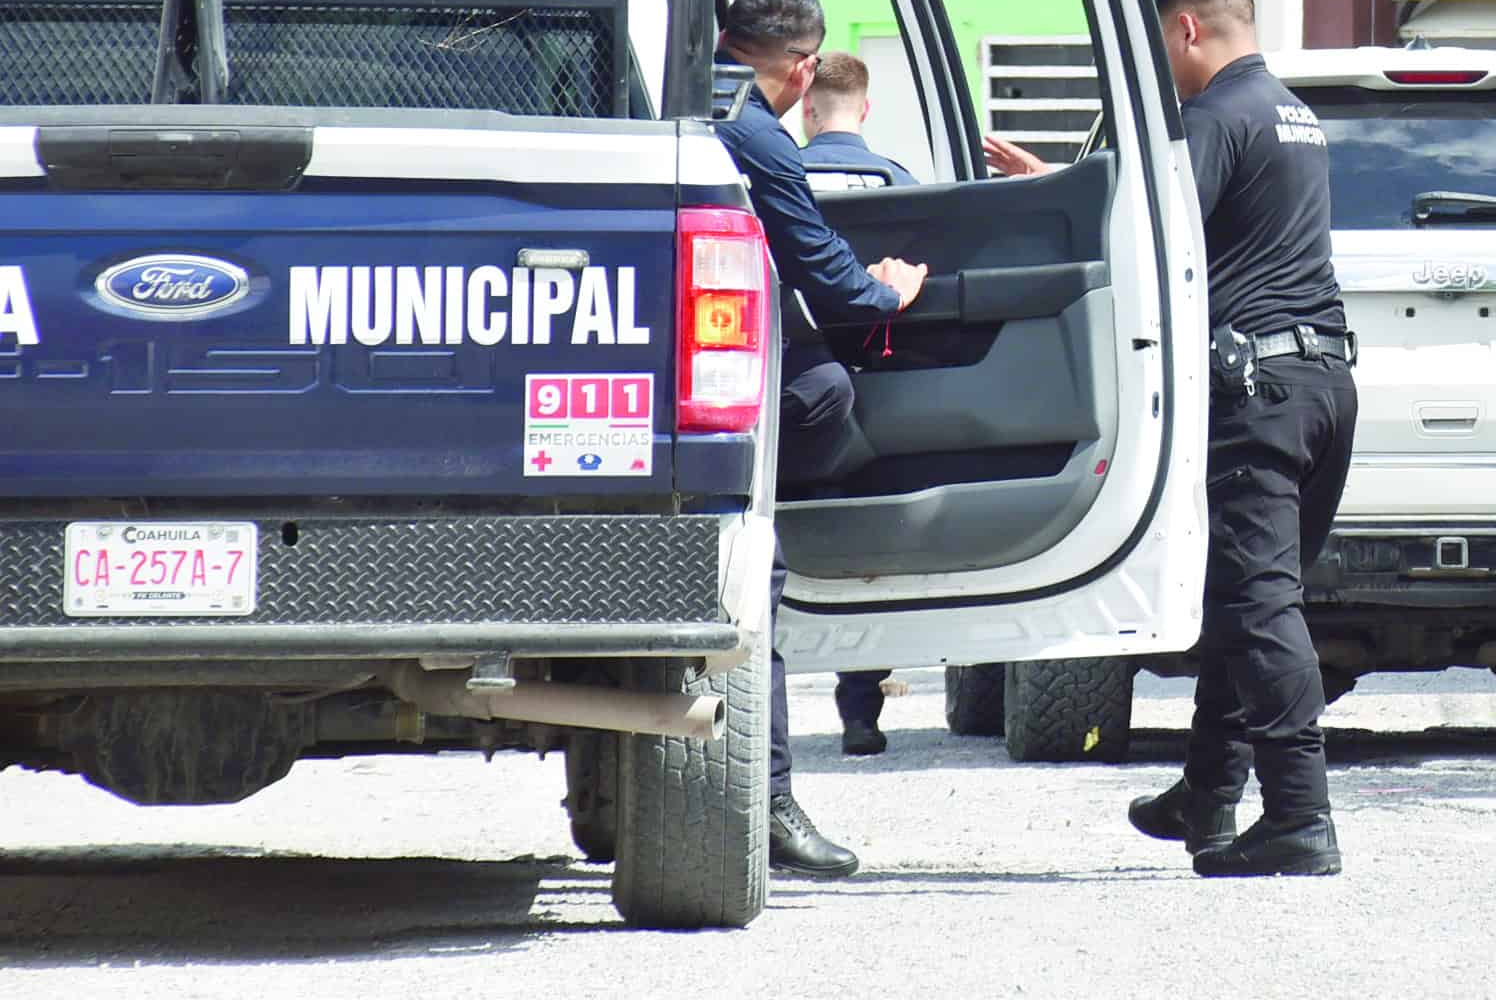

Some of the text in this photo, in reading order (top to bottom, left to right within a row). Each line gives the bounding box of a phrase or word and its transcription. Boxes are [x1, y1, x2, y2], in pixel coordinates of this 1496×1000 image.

[132, 266, 215, 300] Ford
[1412, 260, 1487, 290] Jeep
[289, 265, 650, 346] MUNICIPAL
[536, 384, 638, 415] 911
[528, 433, 649, 446] EMERGENCIAS
[122, 526, 201, 543] COAHUILA
[75, 549, 244, 586] CA-257A-7
